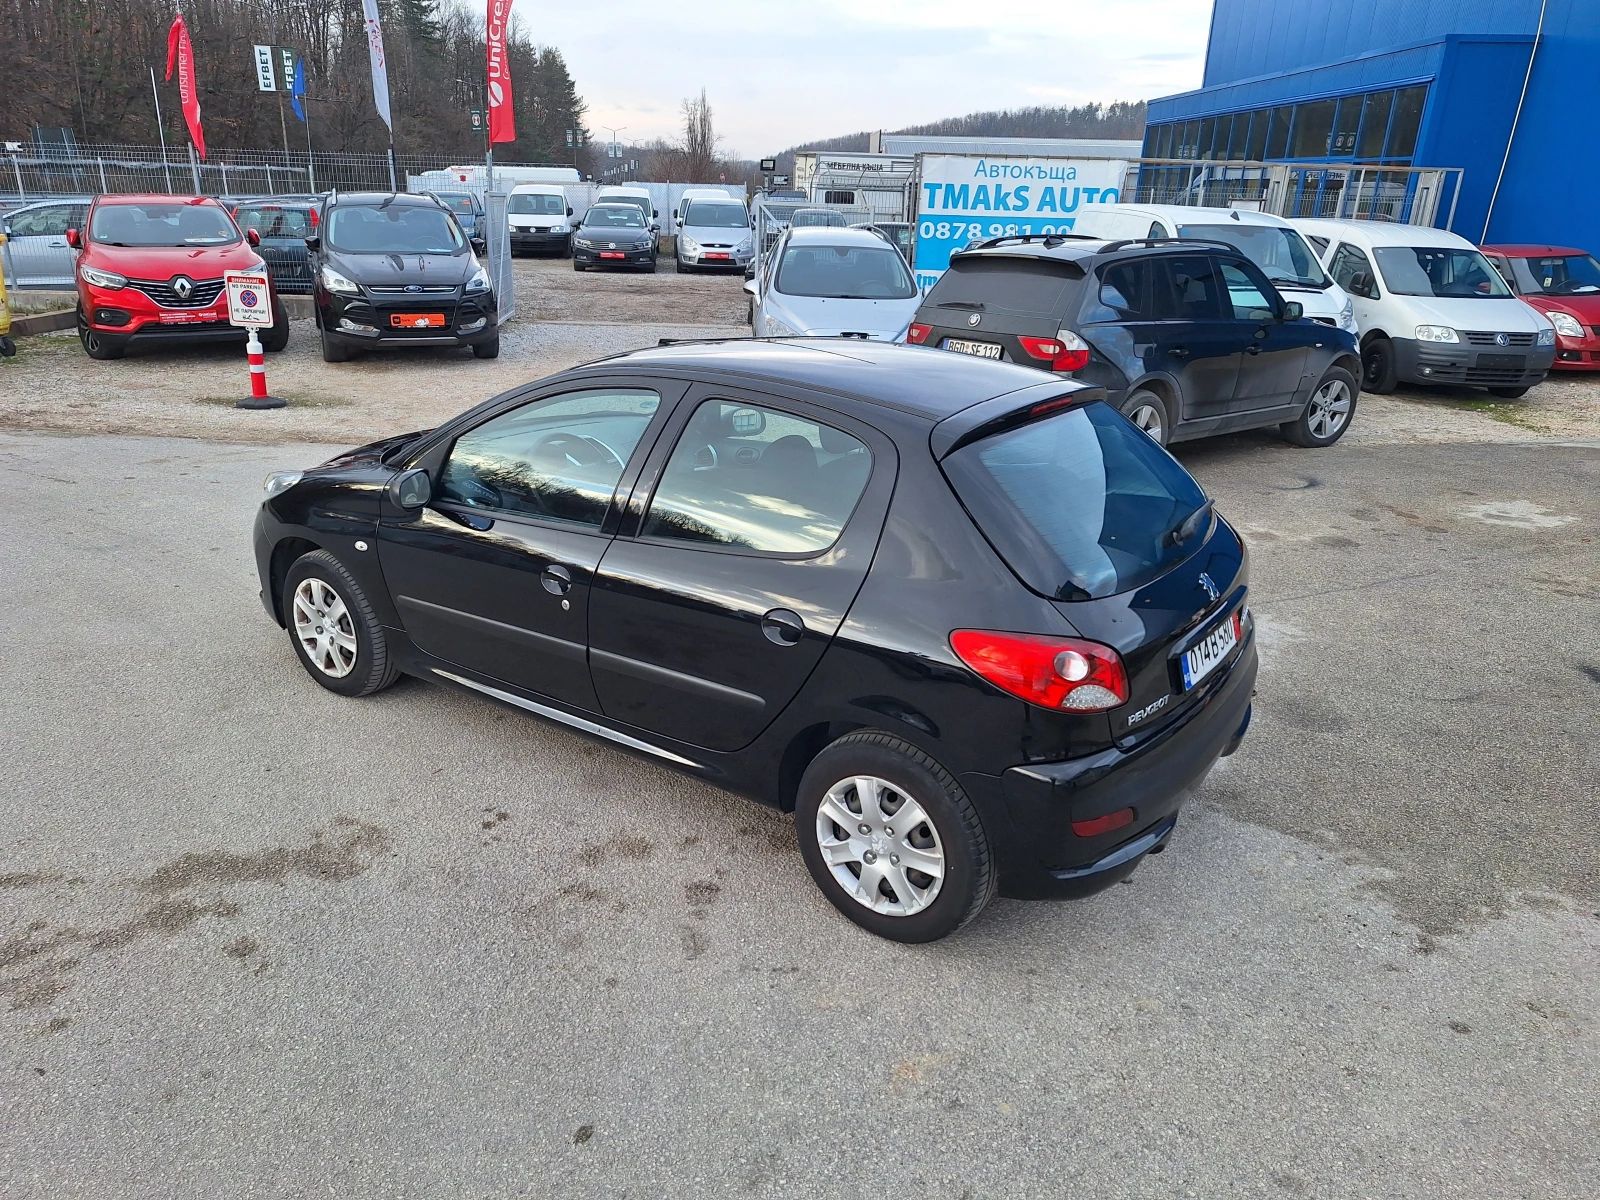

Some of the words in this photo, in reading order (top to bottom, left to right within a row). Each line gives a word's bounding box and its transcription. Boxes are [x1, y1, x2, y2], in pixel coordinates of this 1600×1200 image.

[489, 0, 503, 78] UniCre
[258, 49, 272, 88] EFBET
[283, 49, 294, 90] EFBET
[973, 159, 1077, 183] Автокъща
[923, 182, 1030, 212] TMAkS
[919, 221, 982, 240] 0878
[1040, 224, 1073, 236] 00
[915, 273, 938, 290] tm
[948, 341, 966, 353] BGD
[1127, 693, 1170, 727] PEUGEOT
